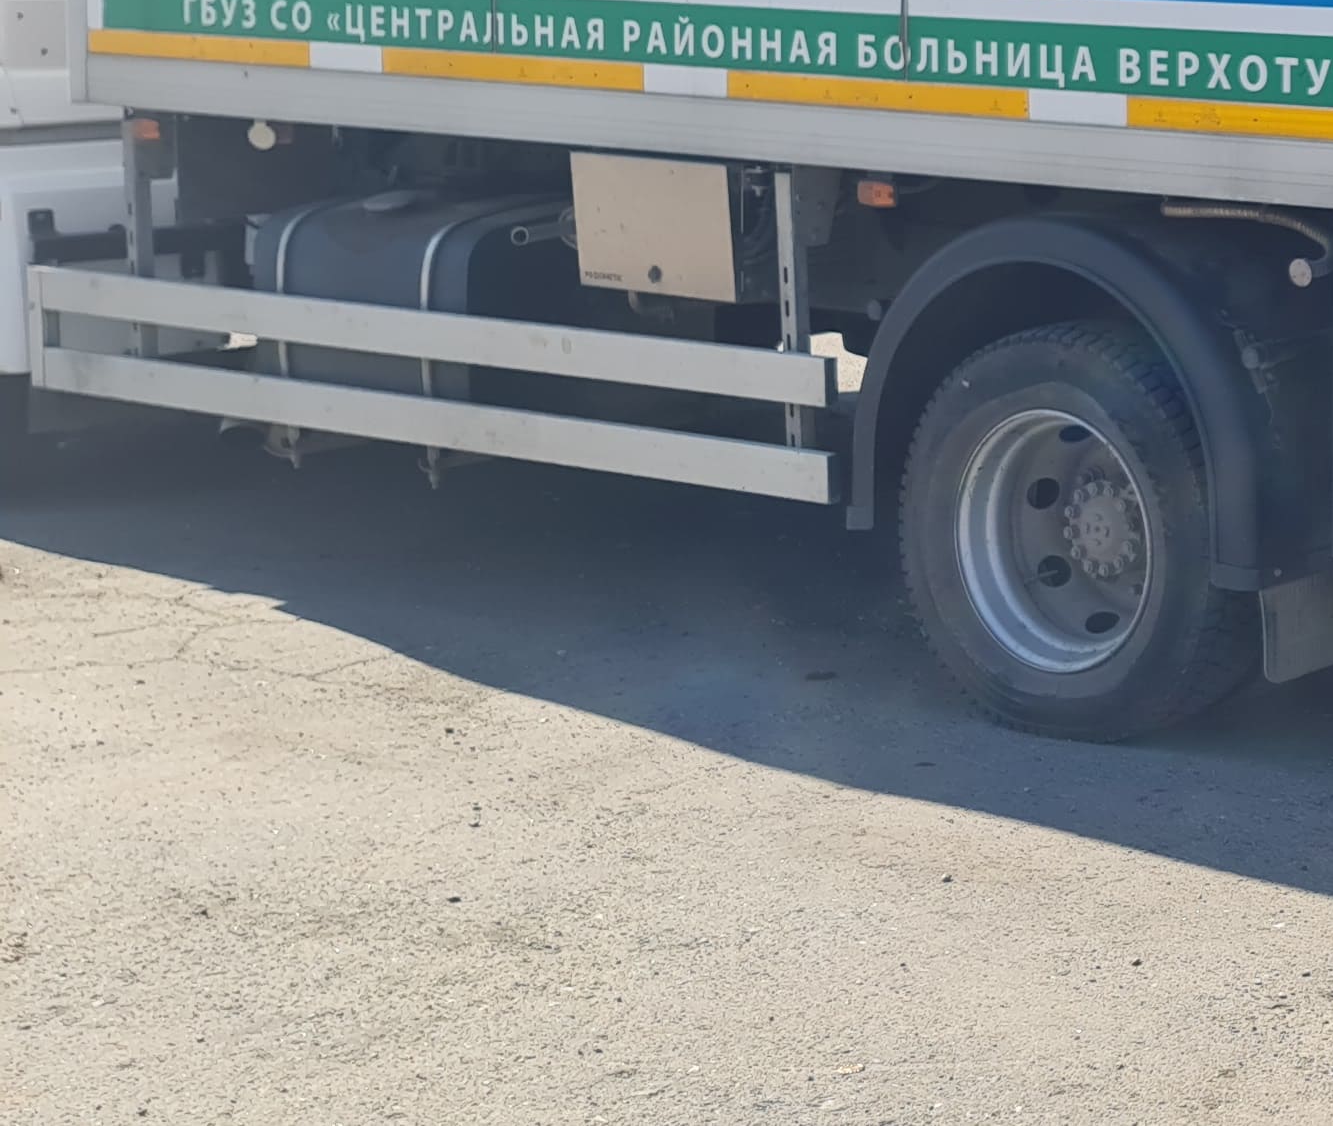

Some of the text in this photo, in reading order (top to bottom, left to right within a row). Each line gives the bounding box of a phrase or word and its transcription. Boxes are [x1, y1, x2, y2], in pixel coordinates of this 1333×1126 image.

[269, 0, 312, 33] СО
[326, 4, 605, 51] «ЦЕНТРАЛЬНАЯ
[621, 16, 838, 67] РАЙОННАЯ
[857, 32, 1097, 88] БОЛЬНИЦА
